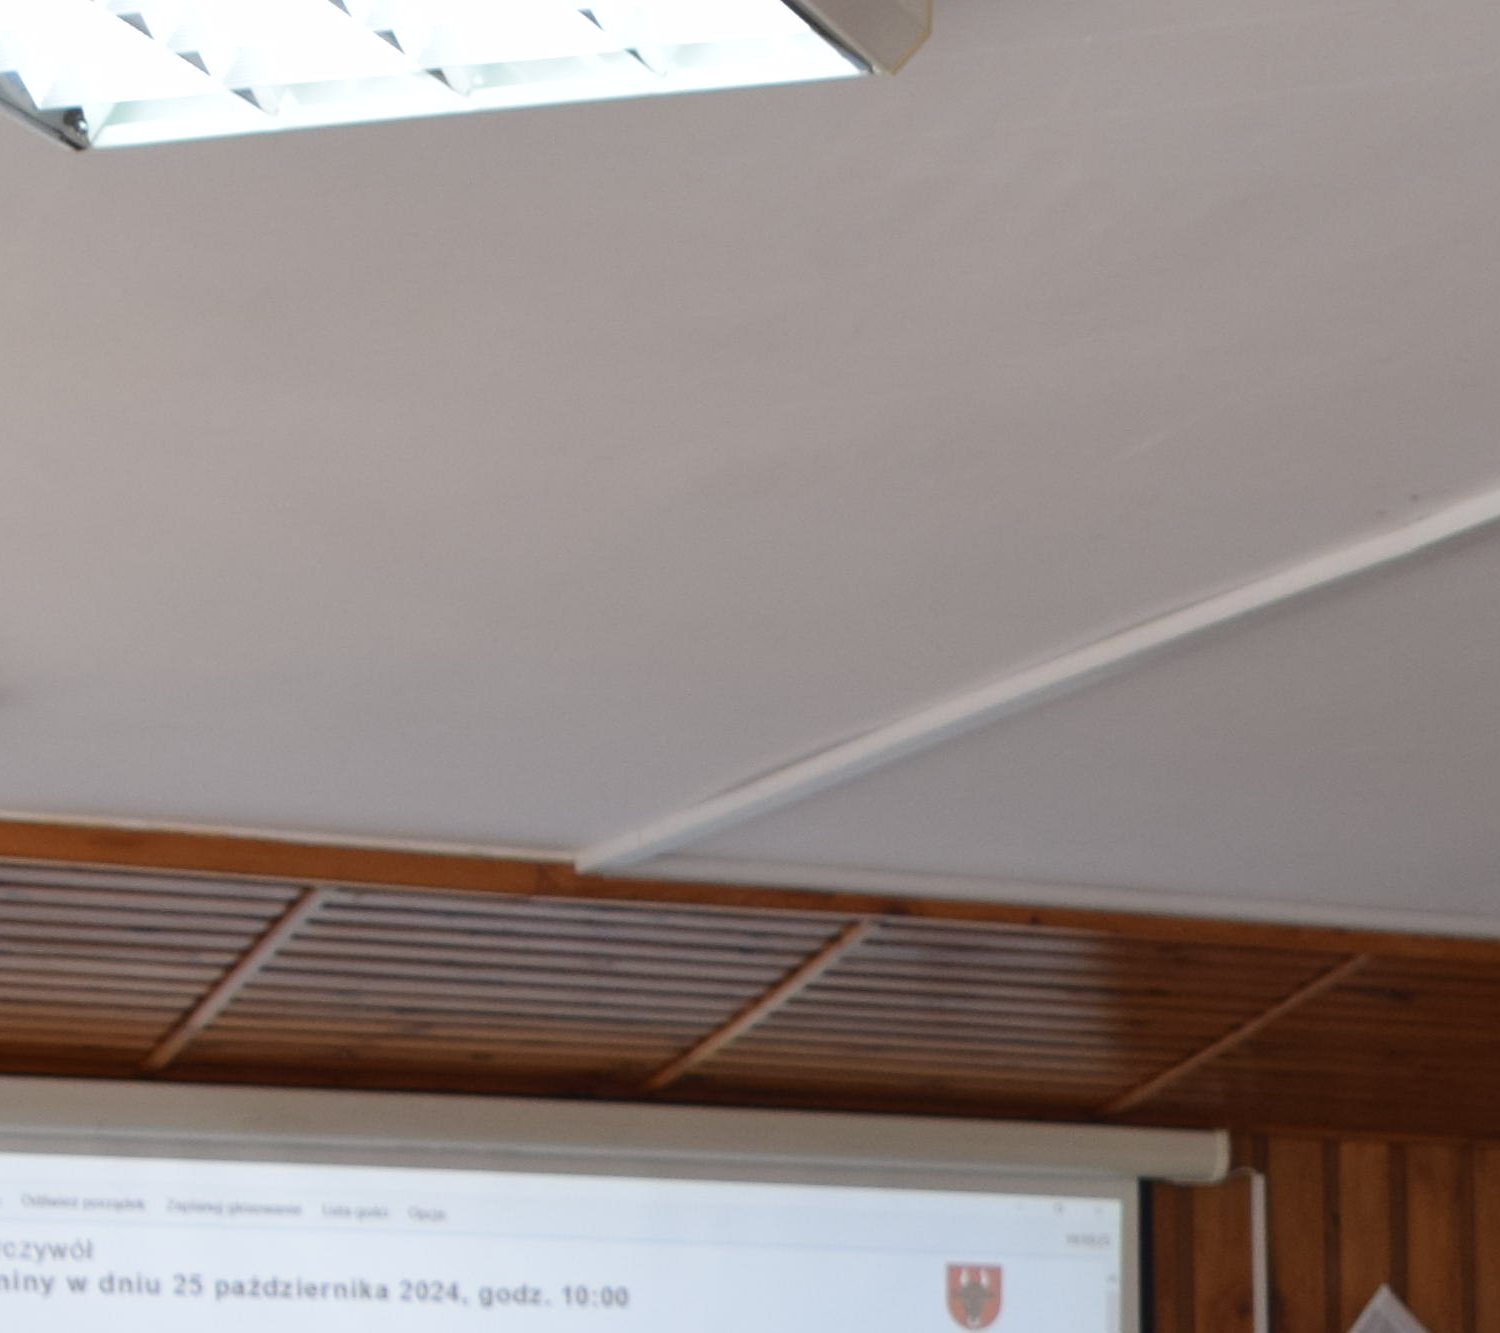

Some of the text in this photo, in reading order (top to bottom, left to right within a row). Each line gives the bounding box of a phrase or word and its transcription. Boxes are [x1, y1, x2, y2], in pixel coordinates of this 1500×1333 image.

[66, 1277, 86, 1293] w
[99, 1271, 162, 1295] dniu
[173, 1273, 203, 1295] 25
[214, 1275, 390, 1303] października
[399, 1279, 468, 1303] 2024,
[479, 1282, 551, 1307] godz.
[561, 1286, 629, 1307] 10:00
